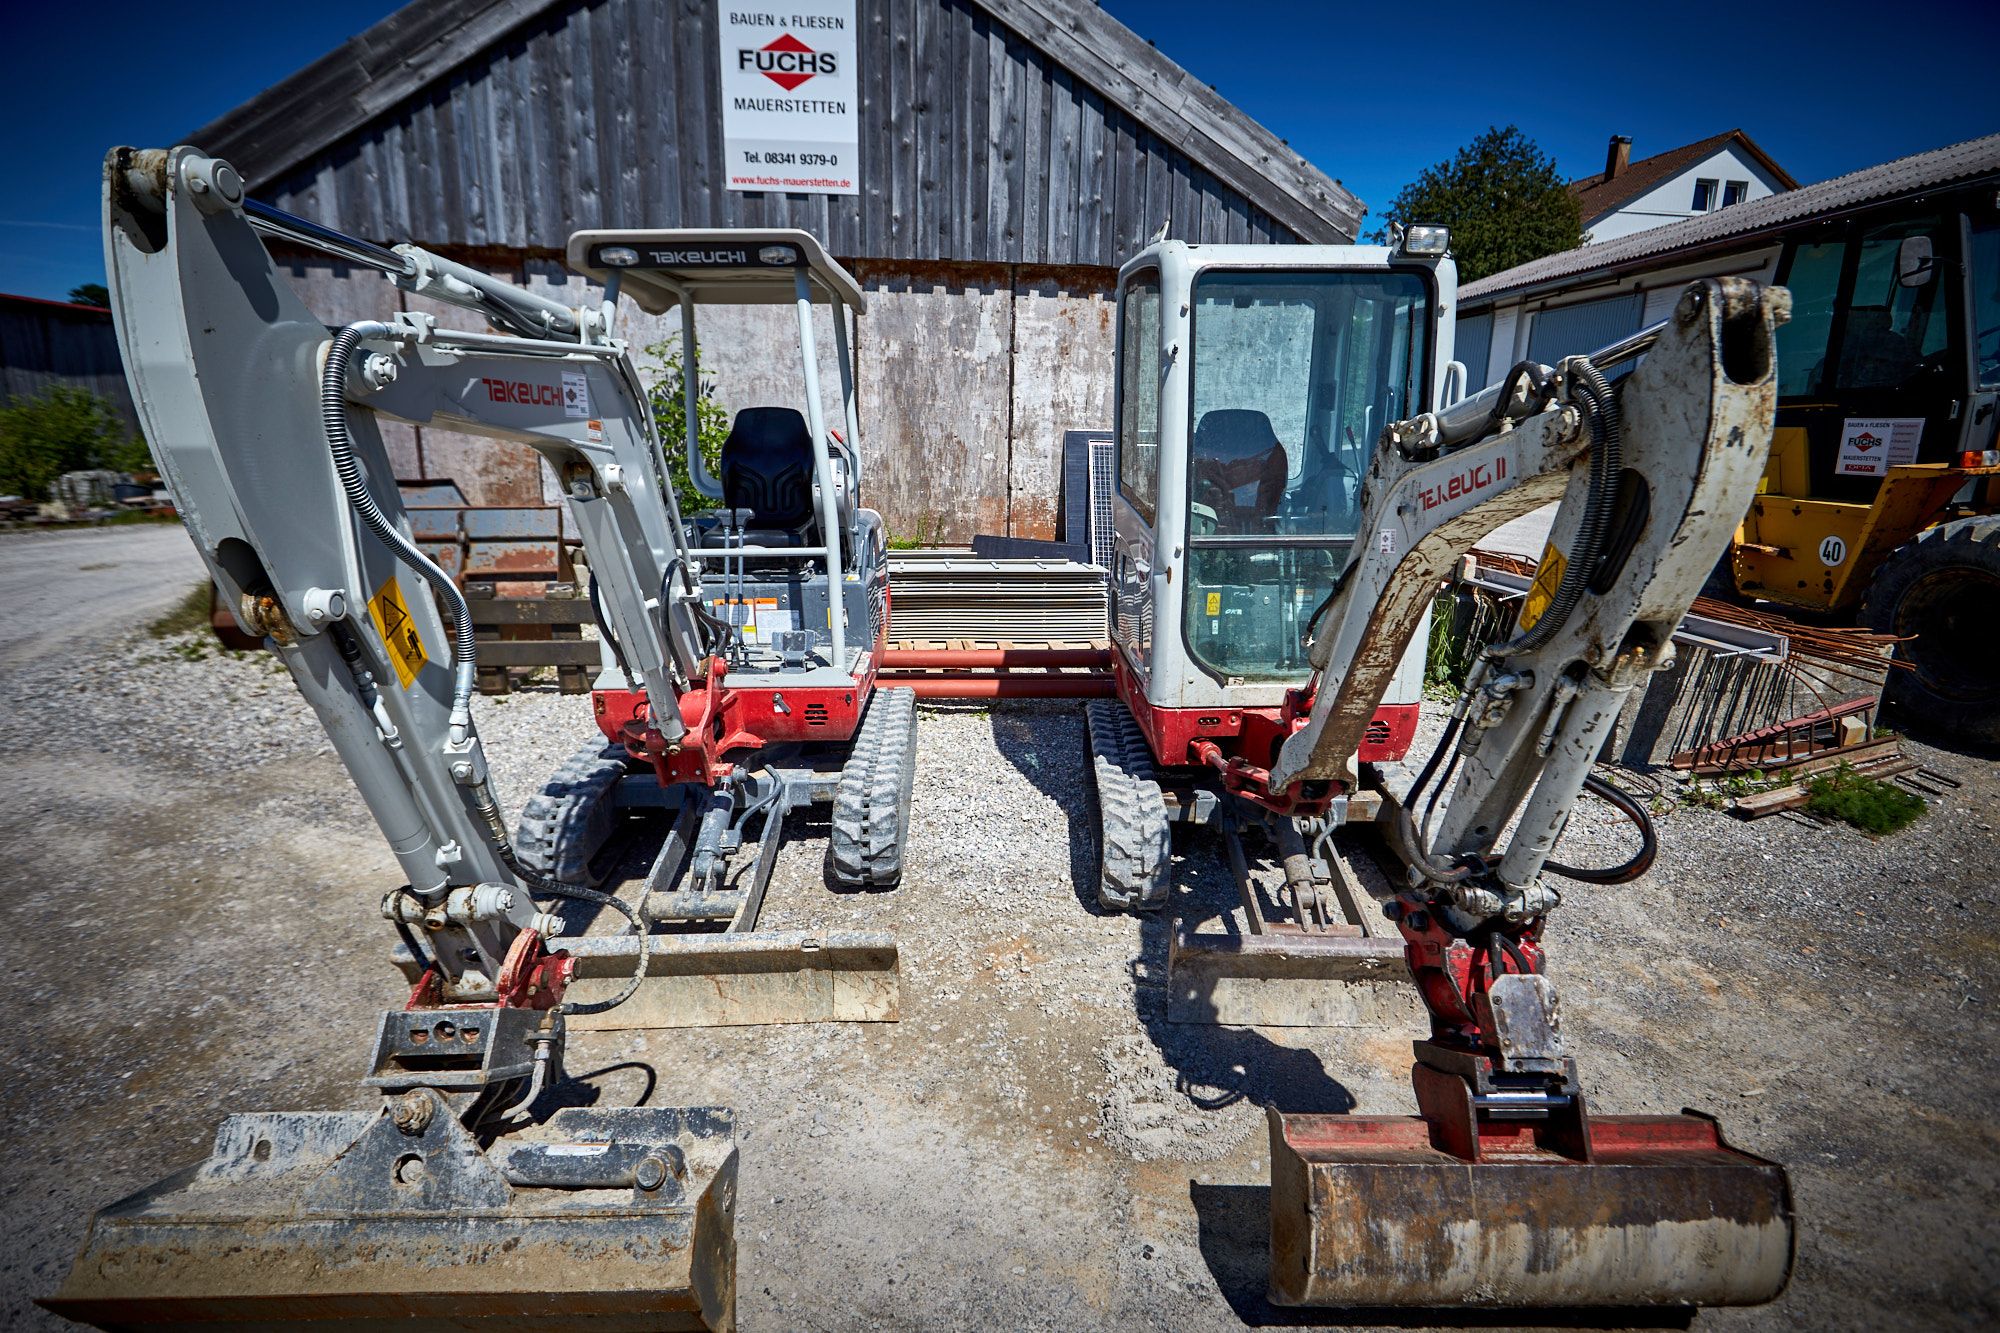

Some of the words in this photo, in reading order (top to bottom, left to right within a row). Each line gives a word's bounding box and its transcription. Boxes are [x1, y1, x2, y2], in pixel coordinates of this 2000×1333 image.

[730, 12, 775, 27] BAUEN
[779, 16, 788, 27] &
[792, 14, 844, 30] FLIESEN
[738, 49, 836, 74] FUCHS
[734, 97, 846, 114] MAUERSTETTEN
[743, 151, 762, 164] Tel.
[764, 152, 796, 165] 08341
[800, 153, 838, 166] 9379-0
[732, 175, 851, 188] www.fuchs-mauerstetten.de
[649, 251, 747, 264] TAKEUCHI
[1847, 437, 1882, 447] FUCHS
[1822, 540, 1842, 562] 40
